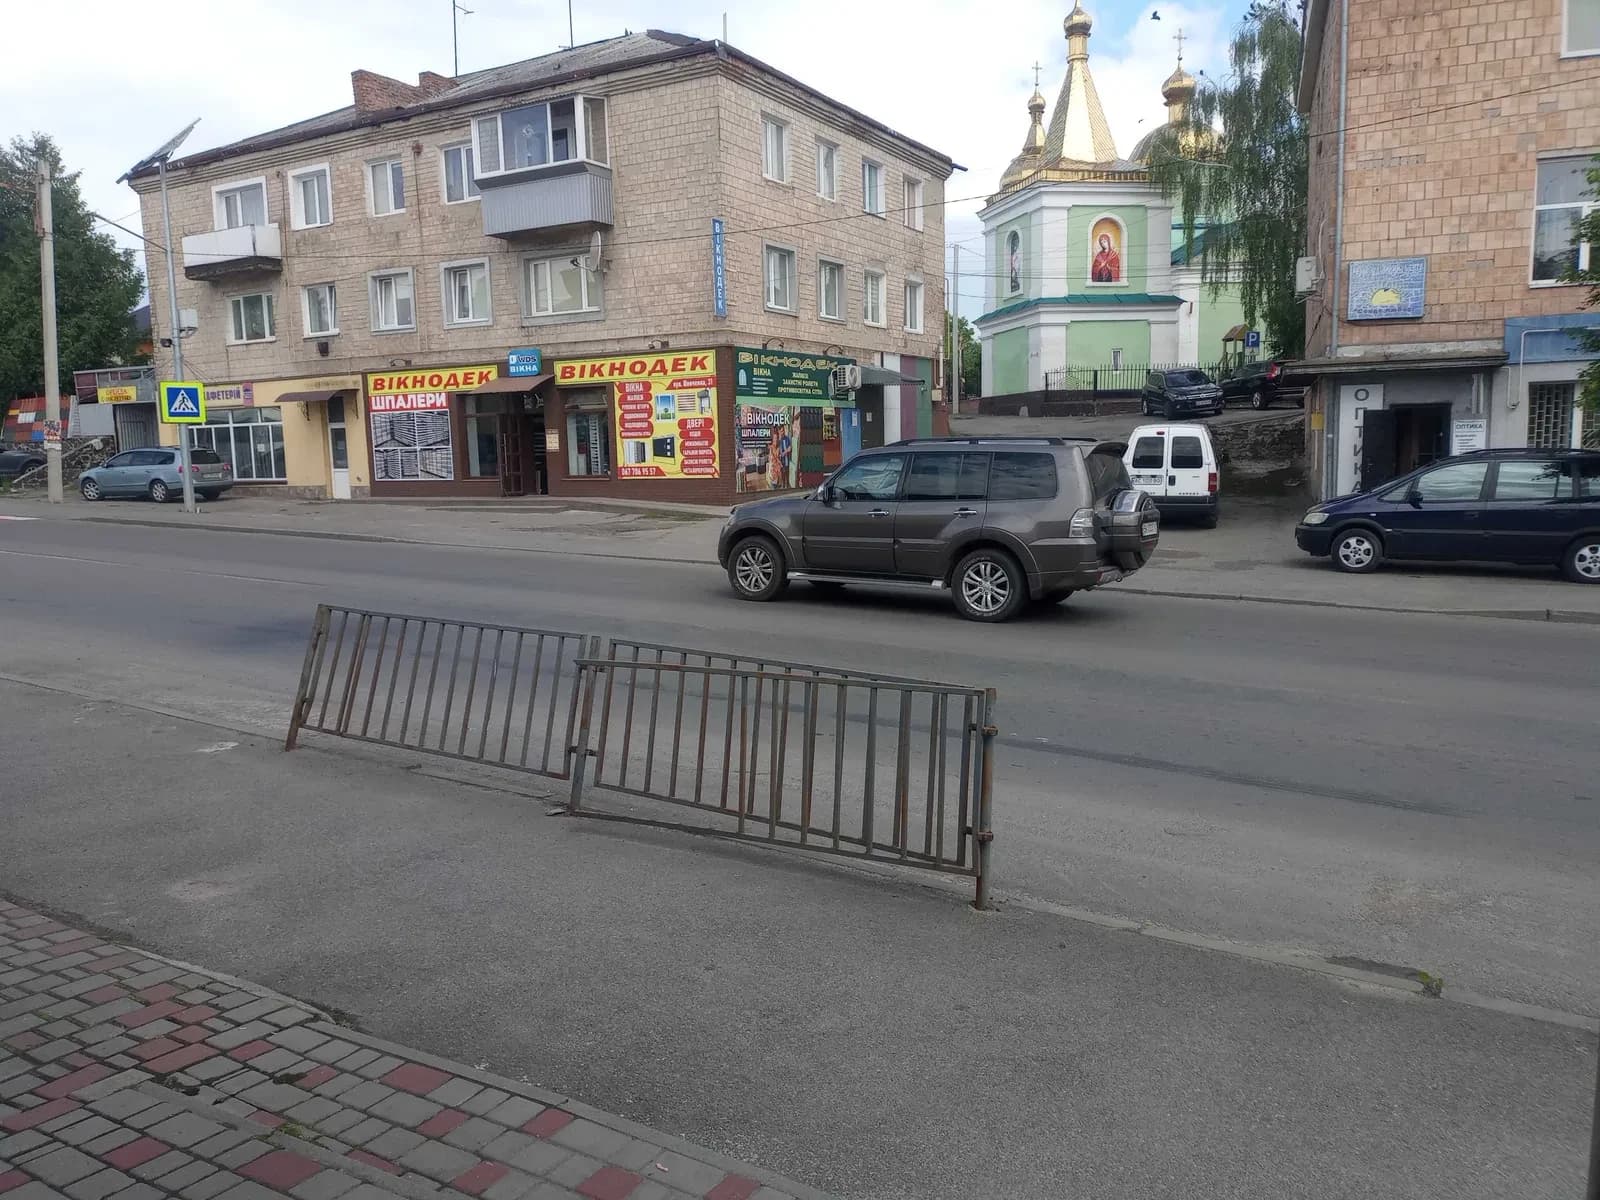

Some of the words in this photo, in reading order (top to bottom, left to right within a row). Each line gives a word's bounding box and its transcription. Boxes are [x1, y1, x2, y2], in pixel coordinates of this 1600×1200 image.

[715, 222, 723, 309] ВІКНОДЕК
[1249, 333, 1258, 346] P
[518, 354, 537, 363] WDS
[738, 352, 838, 372] ВІКНОДЕК
[509, 364, 538, 373] ВІКНА
[560, 355, 709, 379] ВІКНОДЕК
[753, 367, 772, 377] ВІКНА
[372, 370, 492, 391] ВІКНОДЕК
[625, 382, 644, 393] ВІКНА
[203, 390, 241, 401] АФЕТЕРІЙ
[371, 392, 447, 410] ШПАЛЕРИ
[686, 419, 705, 430] ДВЕРІ
[747, 412, 790, 427] ВІКНОДЕК
[741, 428, 771, 438] ШПАЛЕРИ
